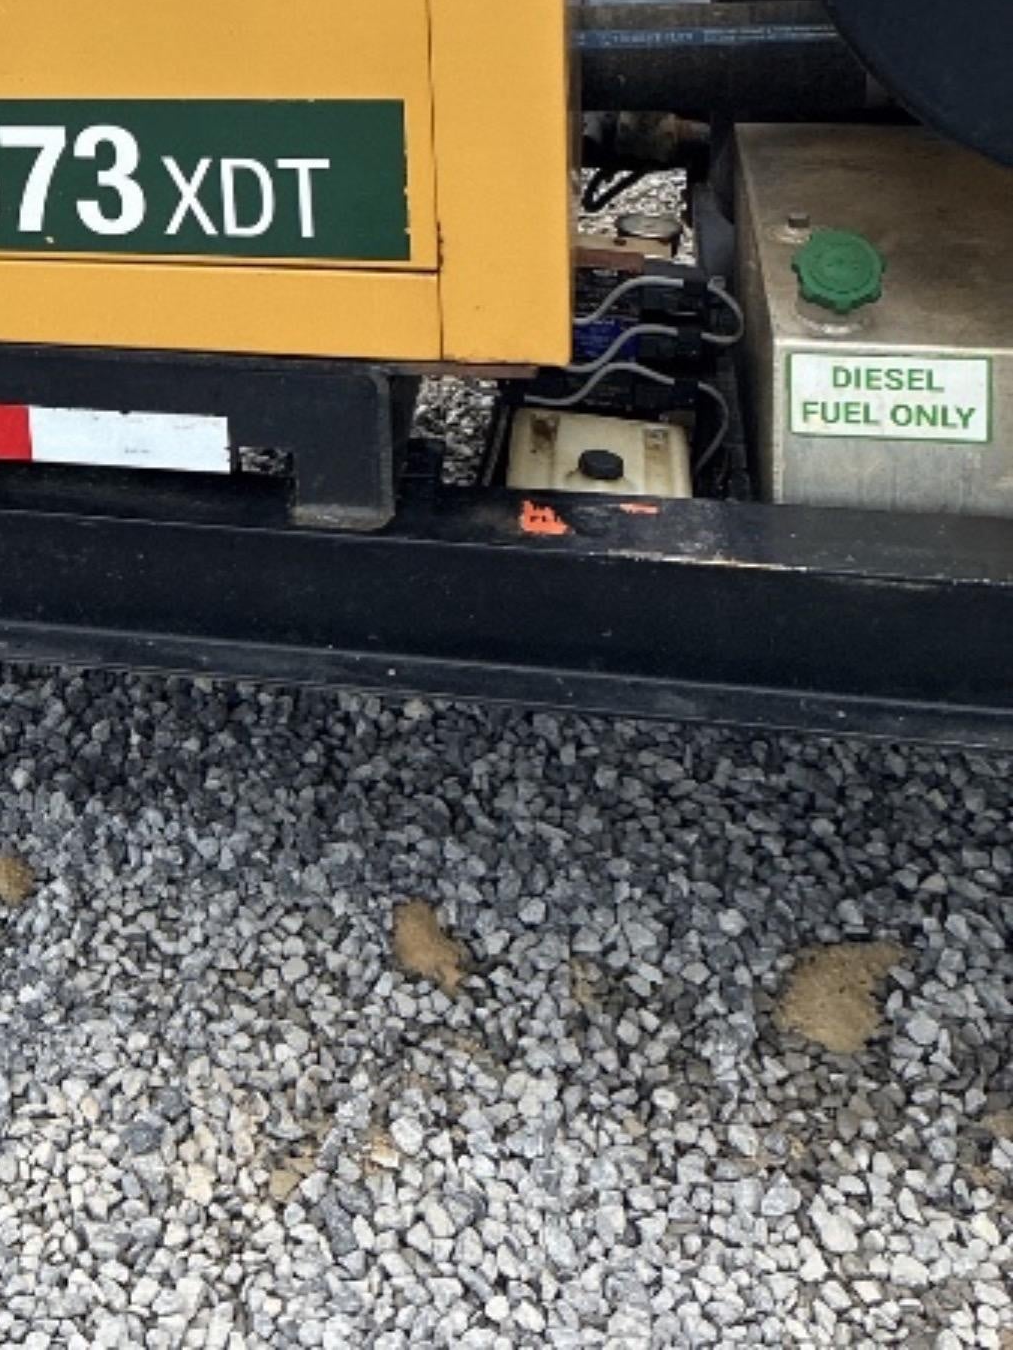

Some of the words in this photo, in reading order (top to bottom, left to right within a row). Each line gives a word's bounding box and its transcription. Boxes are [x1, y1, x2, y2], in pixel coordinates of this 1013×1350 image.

[831, 365, 945, 393] DIESEL
[801, 400, 880, 425] FUEL
[889, 403, 977, 430] ONLY
